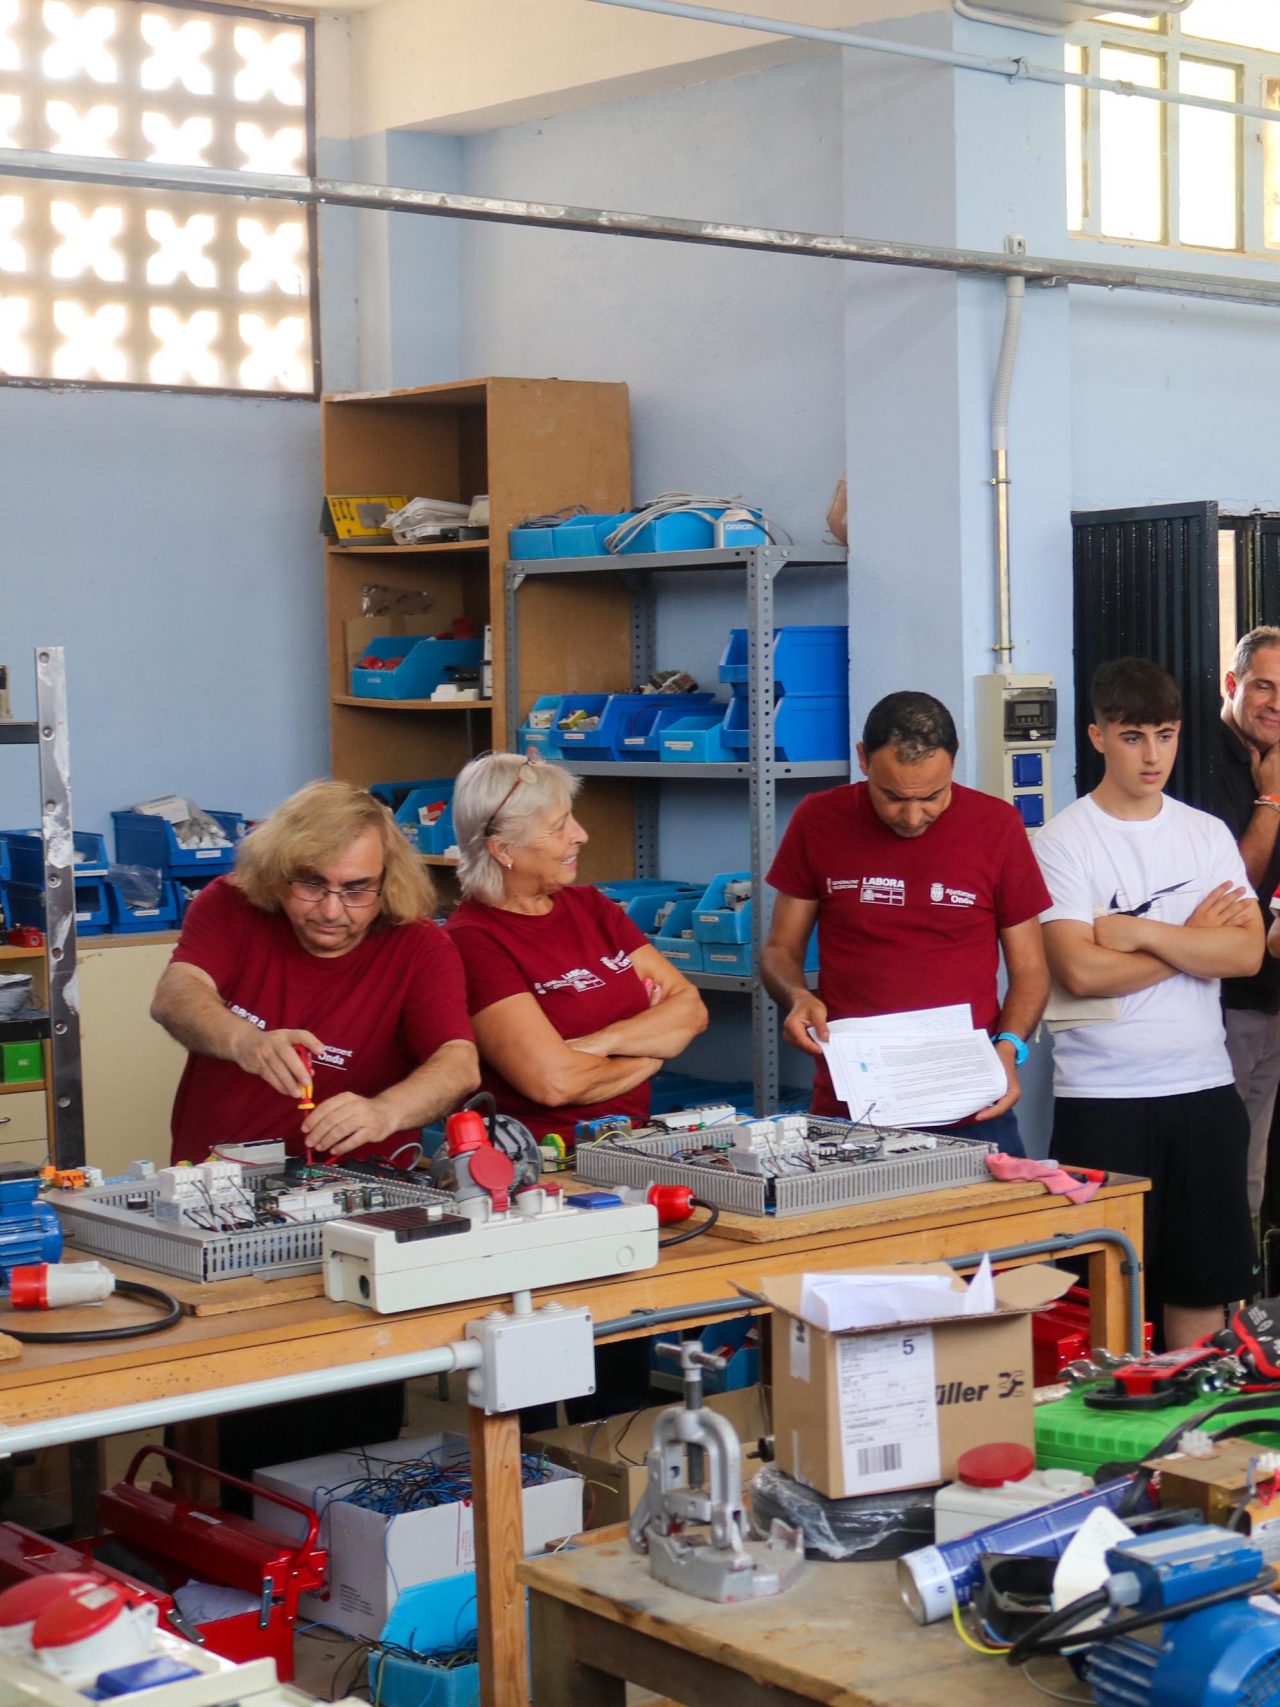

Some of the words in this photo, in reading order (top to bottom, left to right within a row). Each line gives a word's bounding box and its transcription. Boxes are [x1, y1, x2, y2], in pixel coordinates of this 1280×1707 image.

[862, 877, 905, 888] LABORA
[902, 1338, 915, 1355] 5
[935, 1382, 989, 1406] üller
